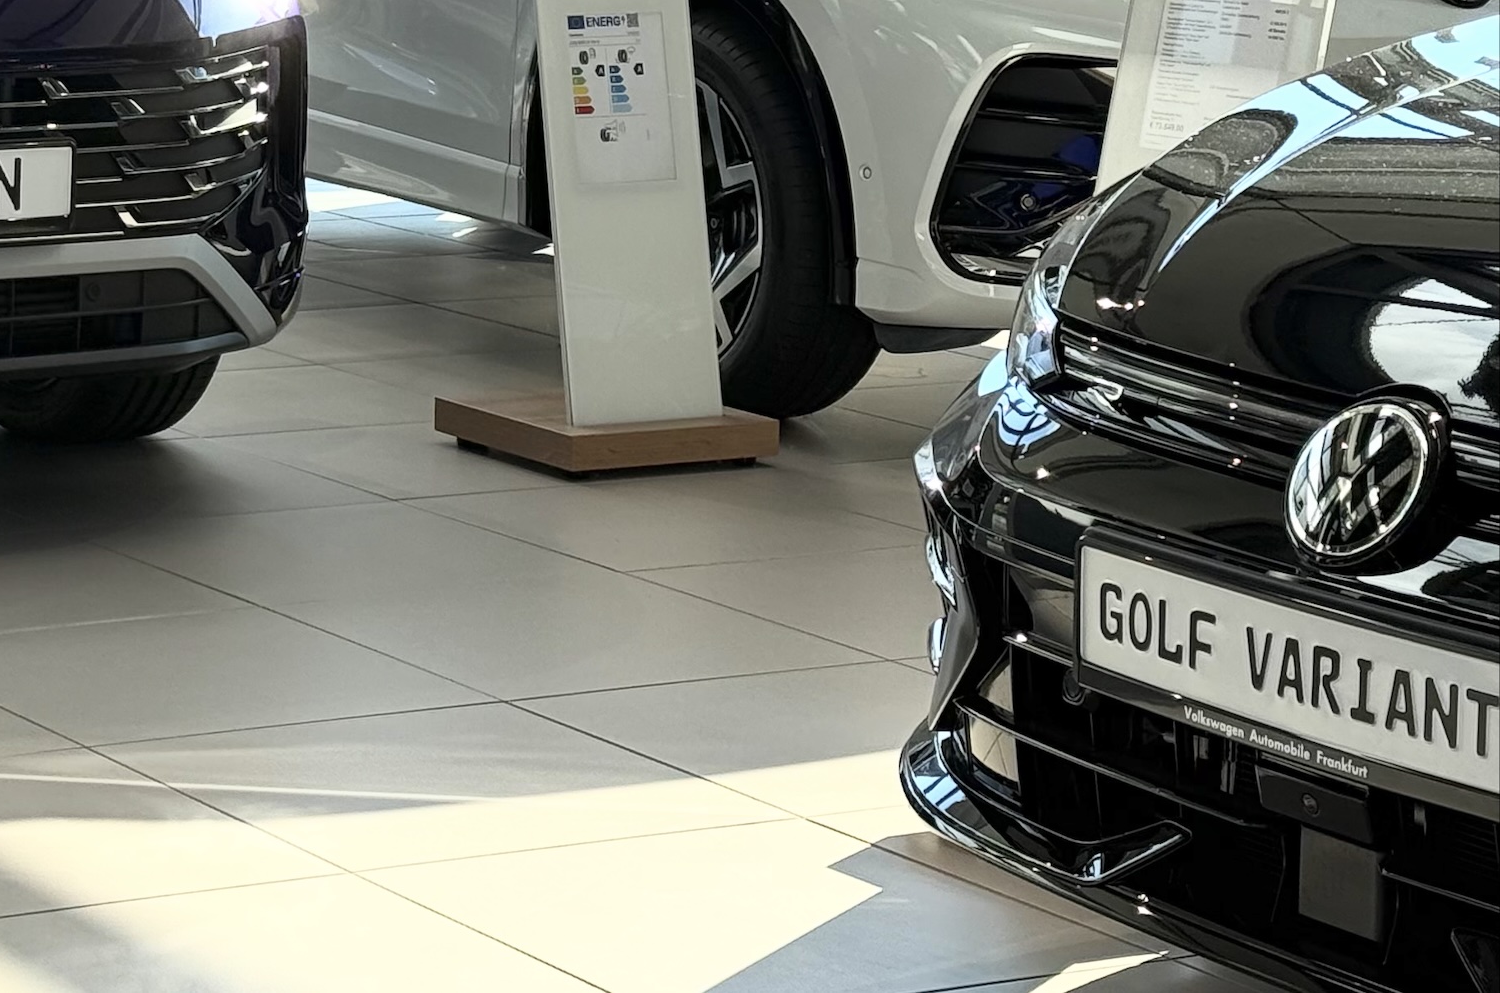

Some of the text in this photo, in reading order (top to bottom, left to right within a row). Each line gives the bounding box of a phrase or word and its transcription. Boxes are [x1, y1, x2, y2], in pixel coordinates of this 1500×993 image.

[1099, 581, 1500, 758] GOLF VARIANT
[1183, 705, 1369, 779] Volkswagen Automobile Frankfurt
